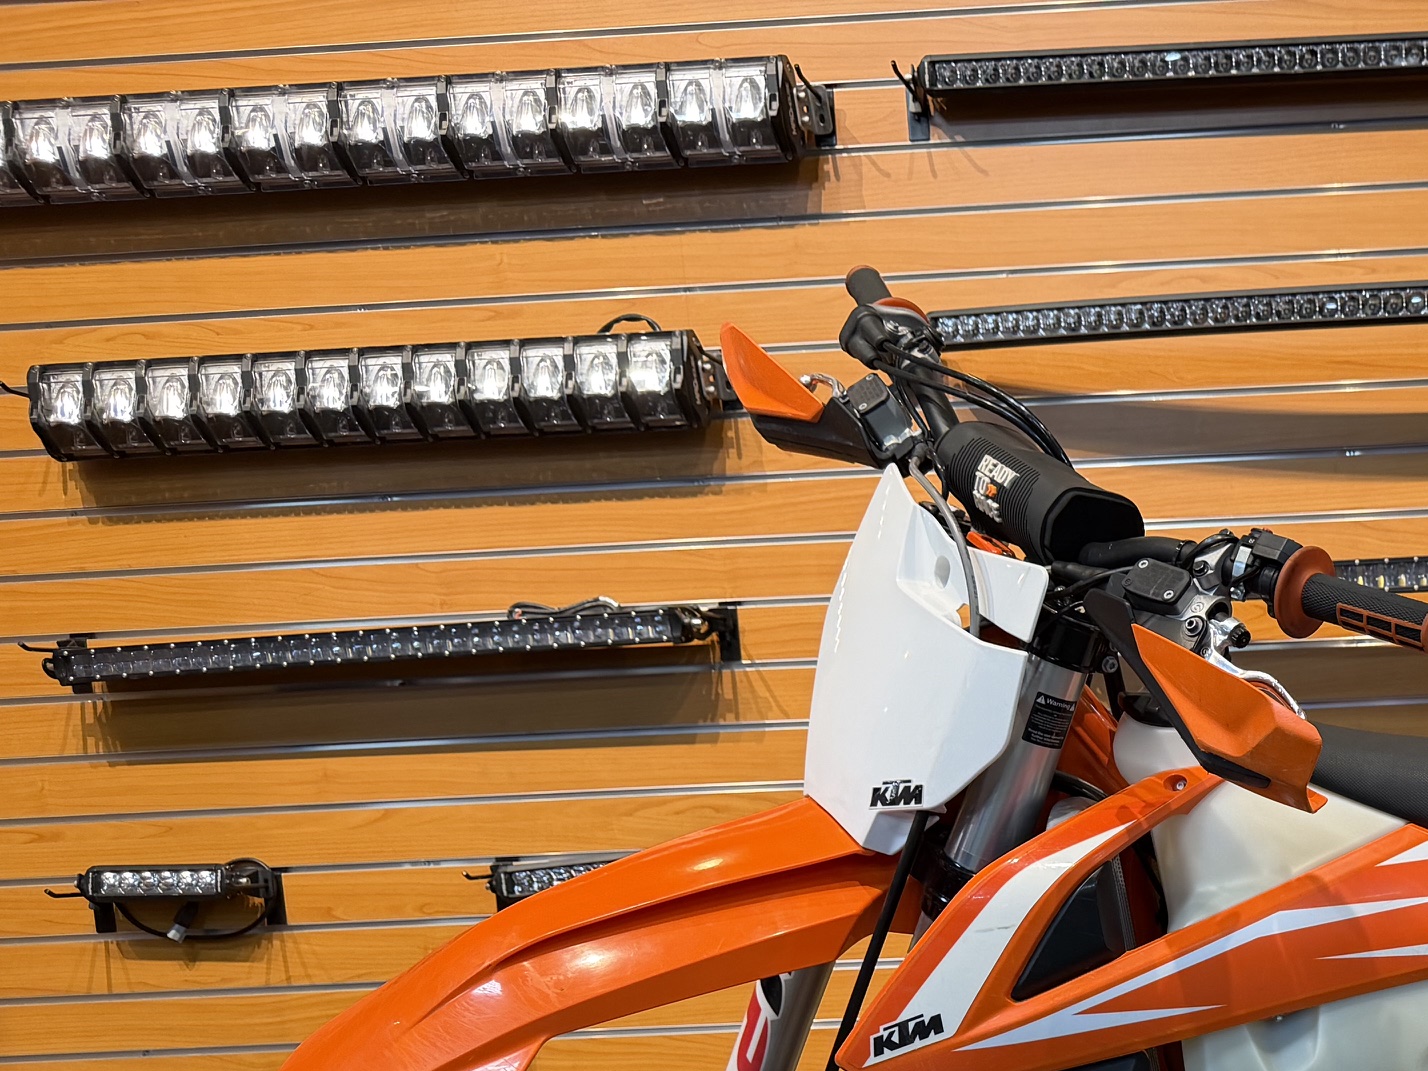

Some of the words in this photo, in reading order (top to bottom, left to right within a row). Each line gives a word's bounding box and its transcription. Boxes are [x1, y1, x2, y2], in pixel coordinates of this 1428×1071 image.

[974, 471, 991, 495] TO
[977, 454, 1020, 488] READY
[1046, 697, 1071, 711] Warning
[869, 779, 923, 808] KTM
[873, 1013, 945, 1058] KTM
